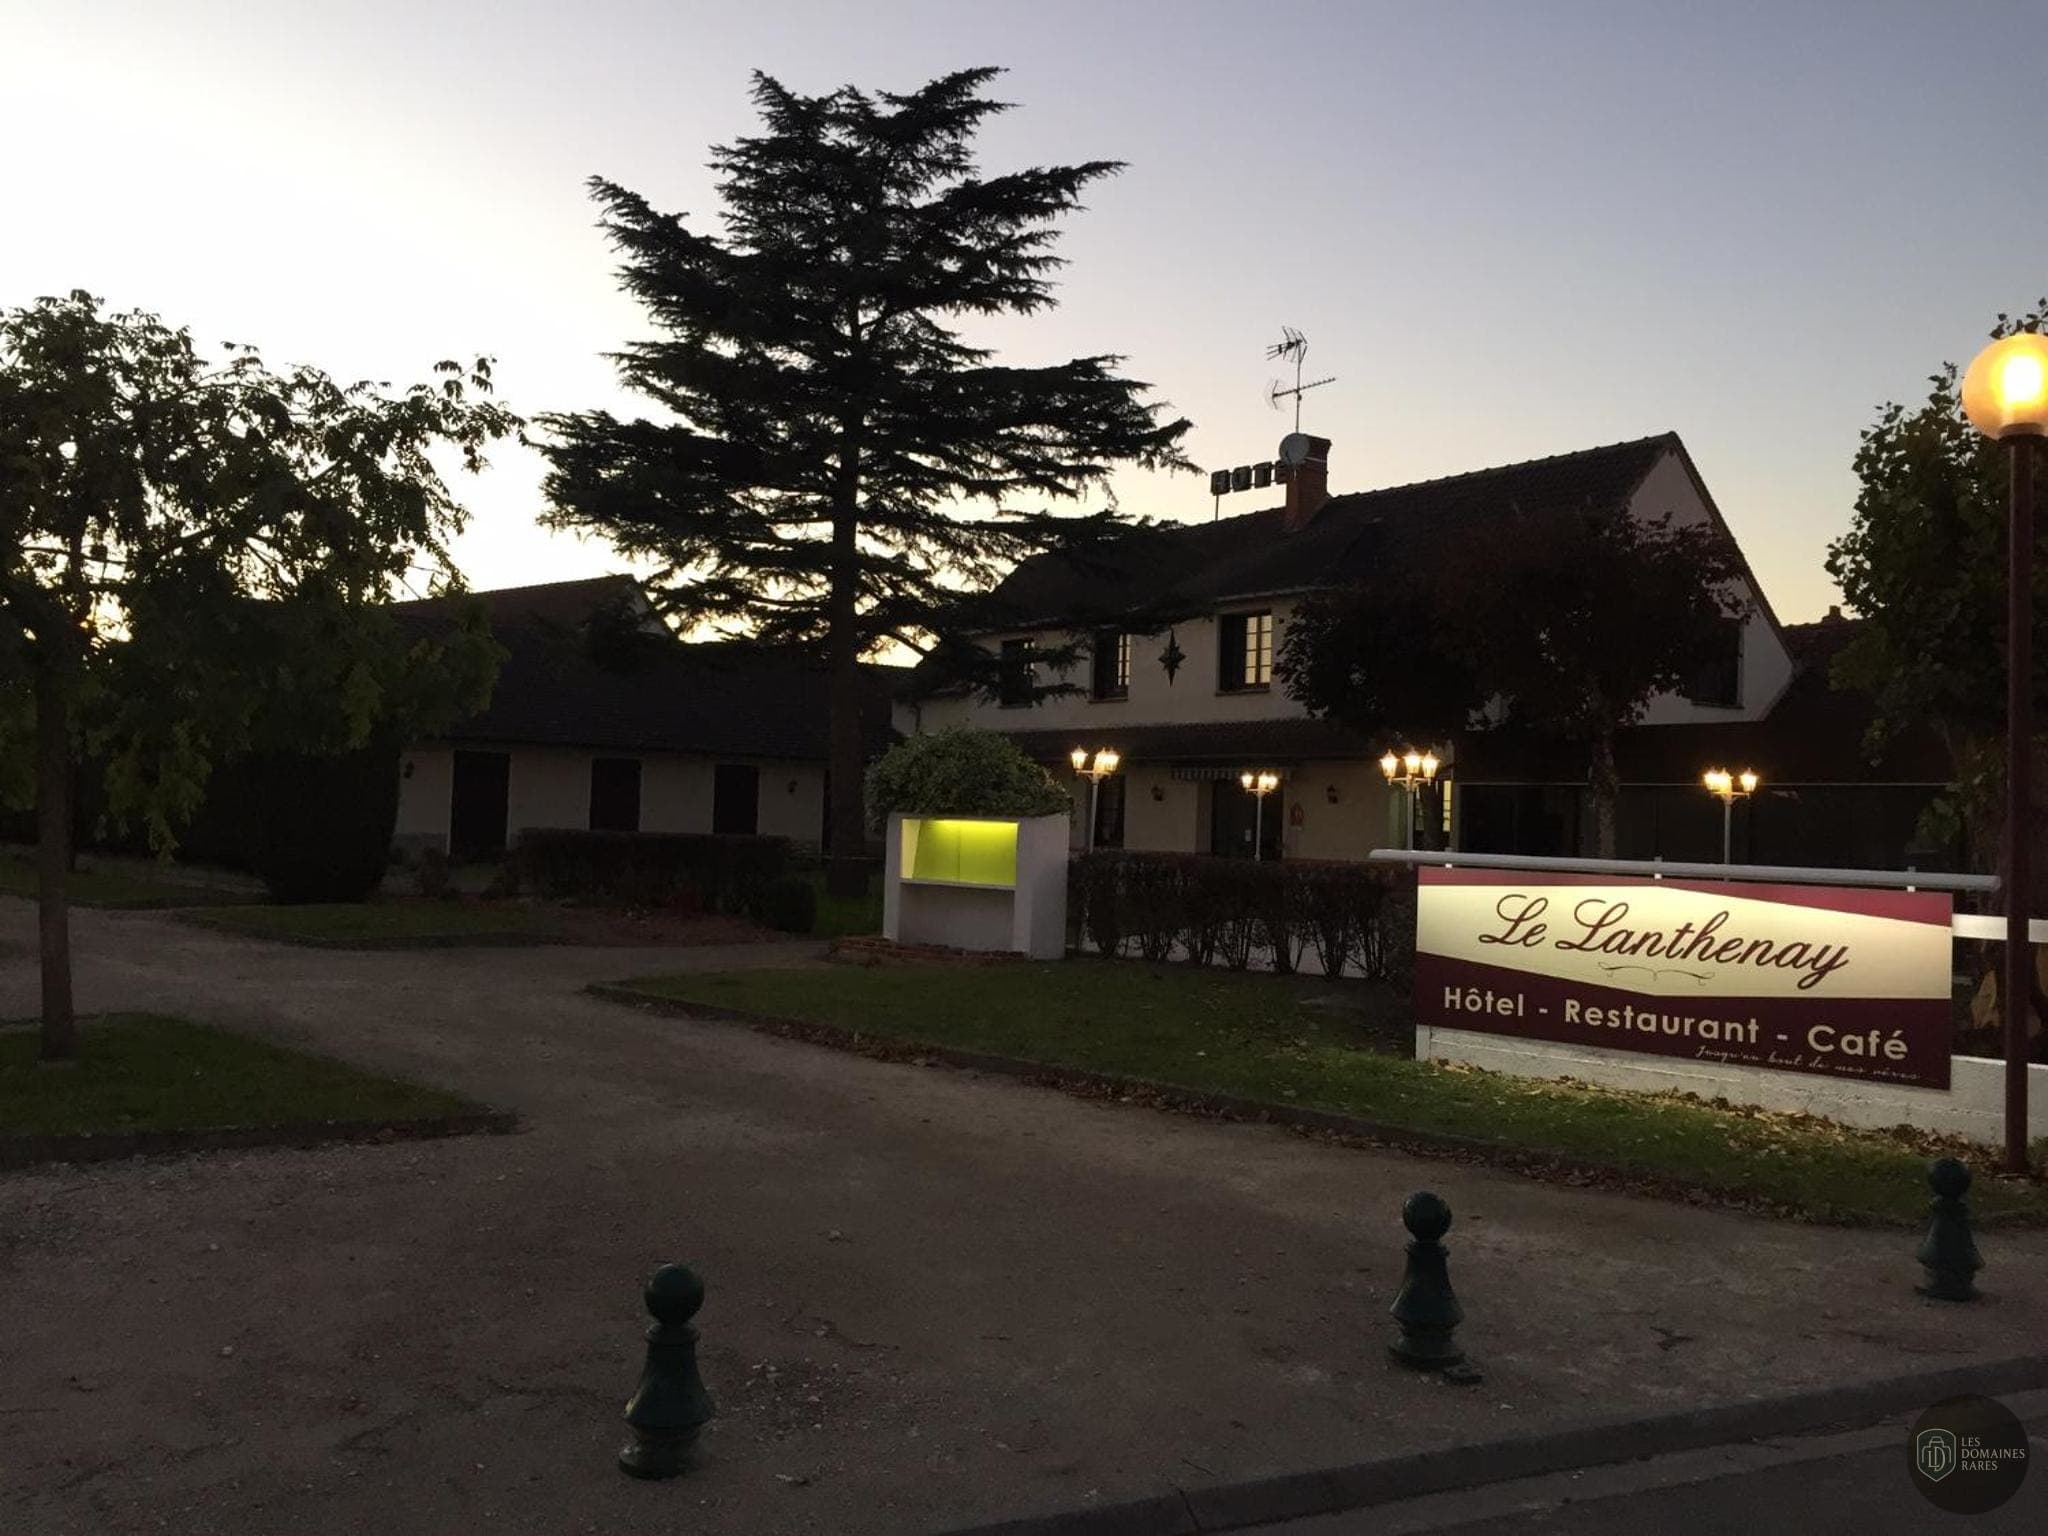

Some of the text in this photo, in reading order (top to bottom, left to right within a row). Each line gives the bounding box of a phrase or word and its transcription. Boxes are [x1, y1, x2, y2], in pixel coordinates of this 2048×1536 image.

[1478, 894, 1850, 990] Le Lanthenay
[1444, 986, 1524, 1018] Hôtel
[1565, 999, 1760, 1044] Restaurant
[1807, 1024, 1909, 1061] Café
